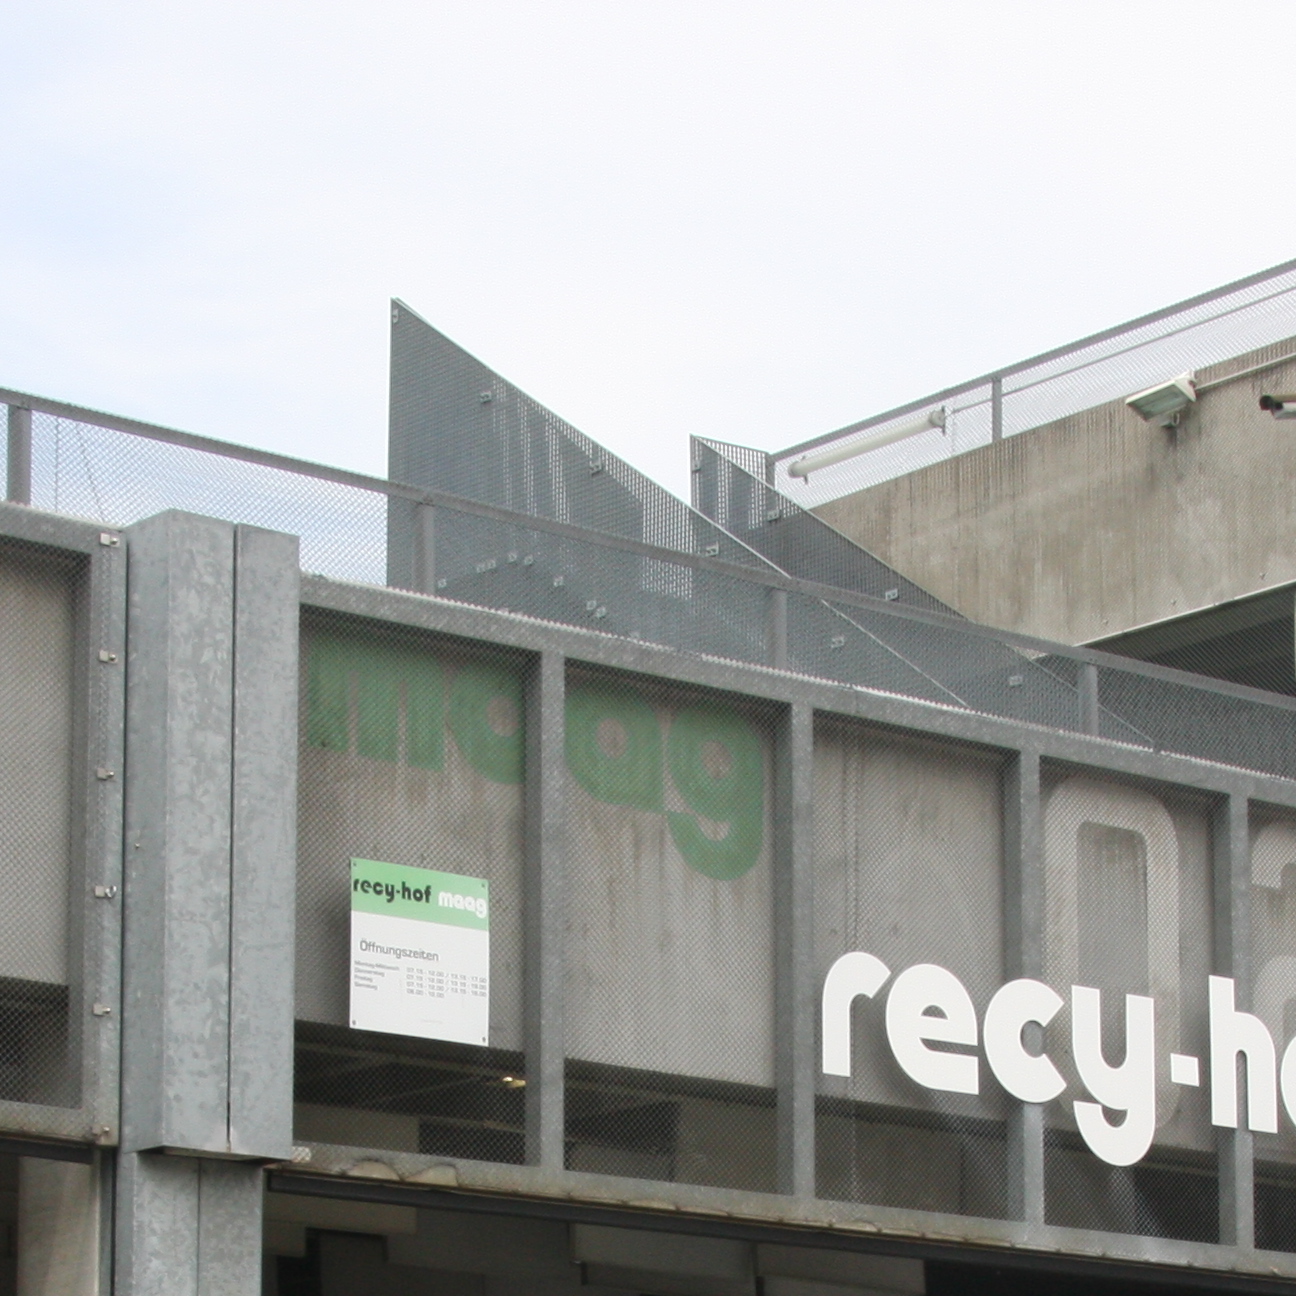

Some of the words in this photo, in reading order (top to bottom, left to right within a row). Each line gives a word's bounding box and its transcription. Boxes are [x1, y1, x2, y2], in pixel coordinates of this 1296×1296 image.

[352, 878, 432, 904] recy-hof
[437, 890, 487, 919] maag
[359, 937, 439, 961] Öffnungszeiten
